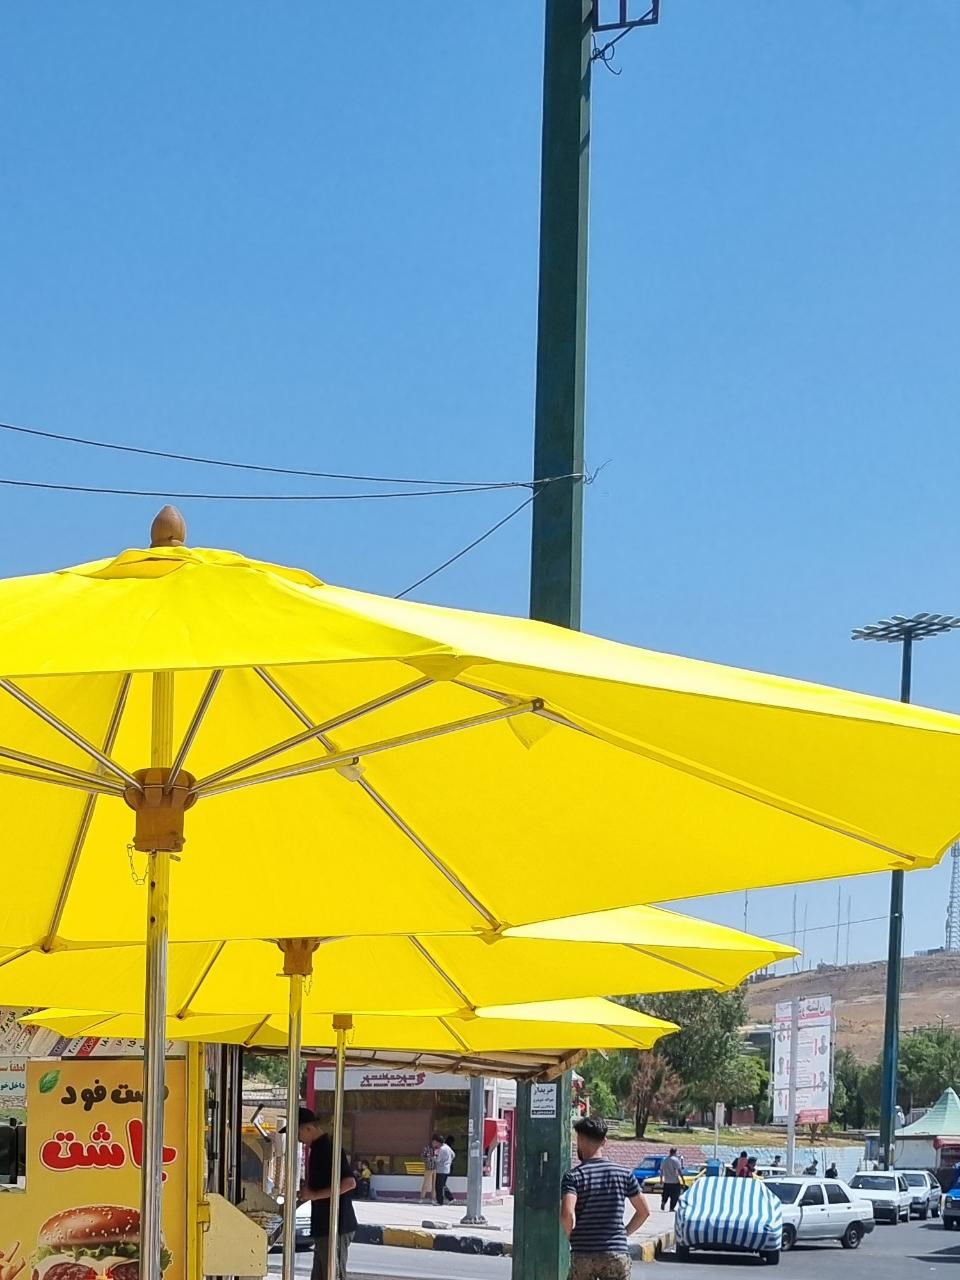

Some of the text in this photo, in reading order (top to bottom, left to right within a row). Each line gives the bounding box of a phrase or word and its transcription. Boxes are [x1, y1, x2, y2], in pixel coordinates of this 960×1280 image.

[9, 1081, 26, 1091] داخل
[60, 1079, 170, 1111] ست فود
